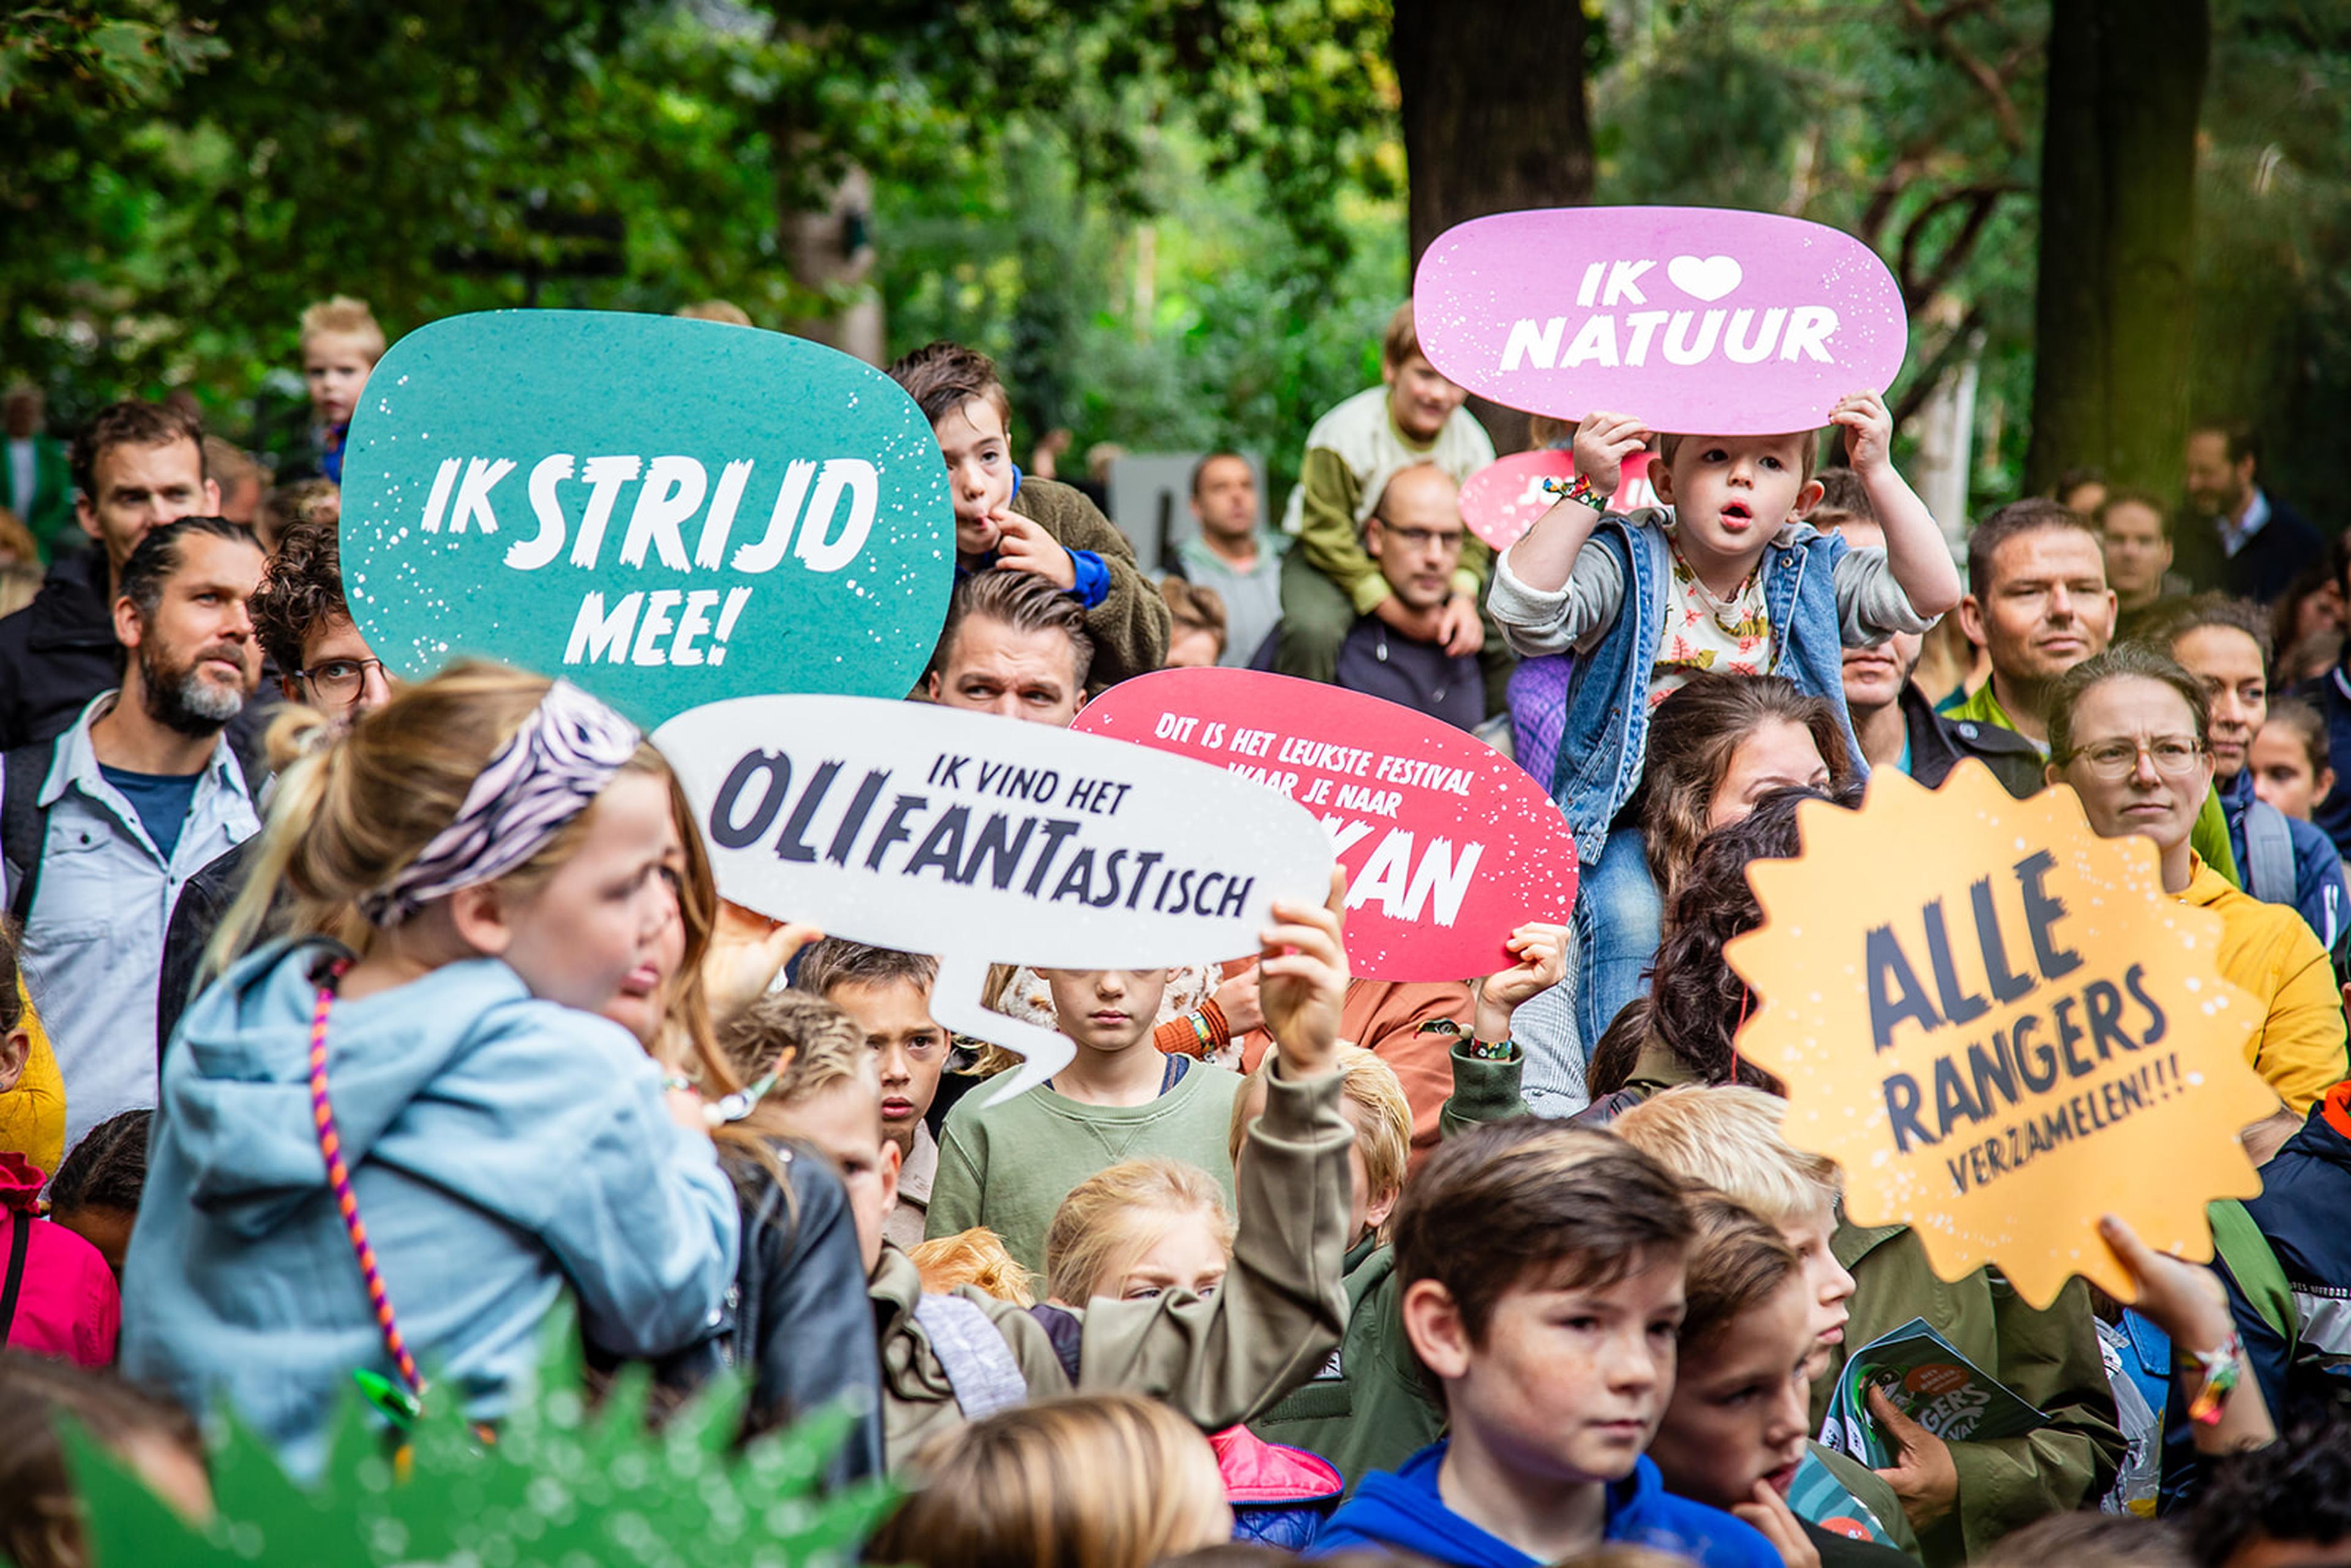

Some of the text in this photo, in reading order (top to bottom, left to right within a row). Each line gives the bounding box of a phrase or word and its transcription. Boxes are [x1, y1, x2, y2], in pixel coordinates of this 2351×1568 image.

[1577, 259, 1657, 307] IK
[1498, 306, 1835, 371] NATUUR
[421, 454, 879, 574] IK STRIJD
[563, 586, 753, 666] MEE!
[927, 754, 1131, 816] IK VIND HET
[1155, 712, 1475, 797] DIT IS HET LEUKSTE FESTIVAL
[710, 748, 1255, 918] OLIFANTASTISCH
[1301, 778, 1333, 805] JE
[1334, 784, 1403, 819] NAAR
[1864, 848, 2083, 1054] ALLE
[1882, 962, 2165, 1155] RANGERS
[1946, 1052, 2184, 1195] VERZAMELEN!!!
[1918, 1382, 1991, 1435] GERS
